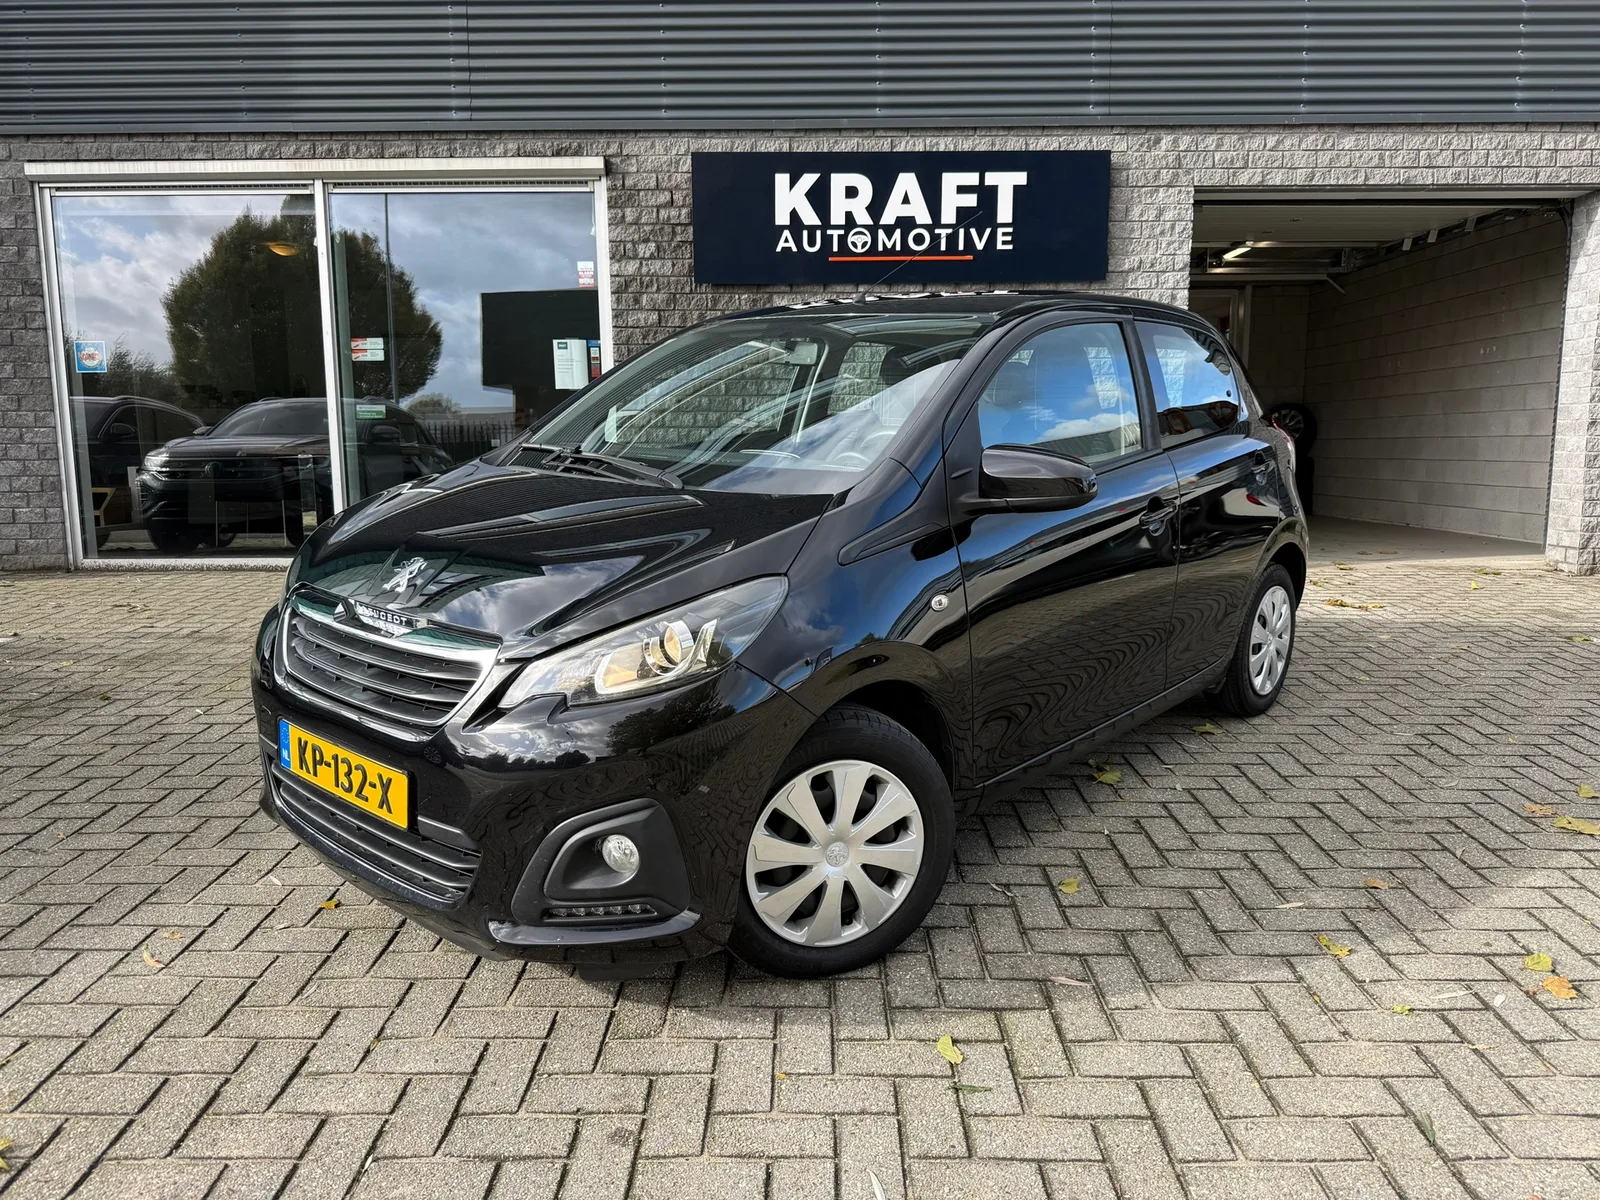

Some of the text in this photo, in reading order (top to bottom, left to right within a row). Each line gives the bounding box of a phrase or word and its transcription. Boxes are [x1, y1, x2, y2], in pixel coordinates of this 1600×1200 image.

[774, 171, 1028, 226] KRAFT
[775, 227, 1014, 253] AUTOMOTIVE
[282, 748, 290, 761] NL
[297, 736, 393, 815] KP-132-X
